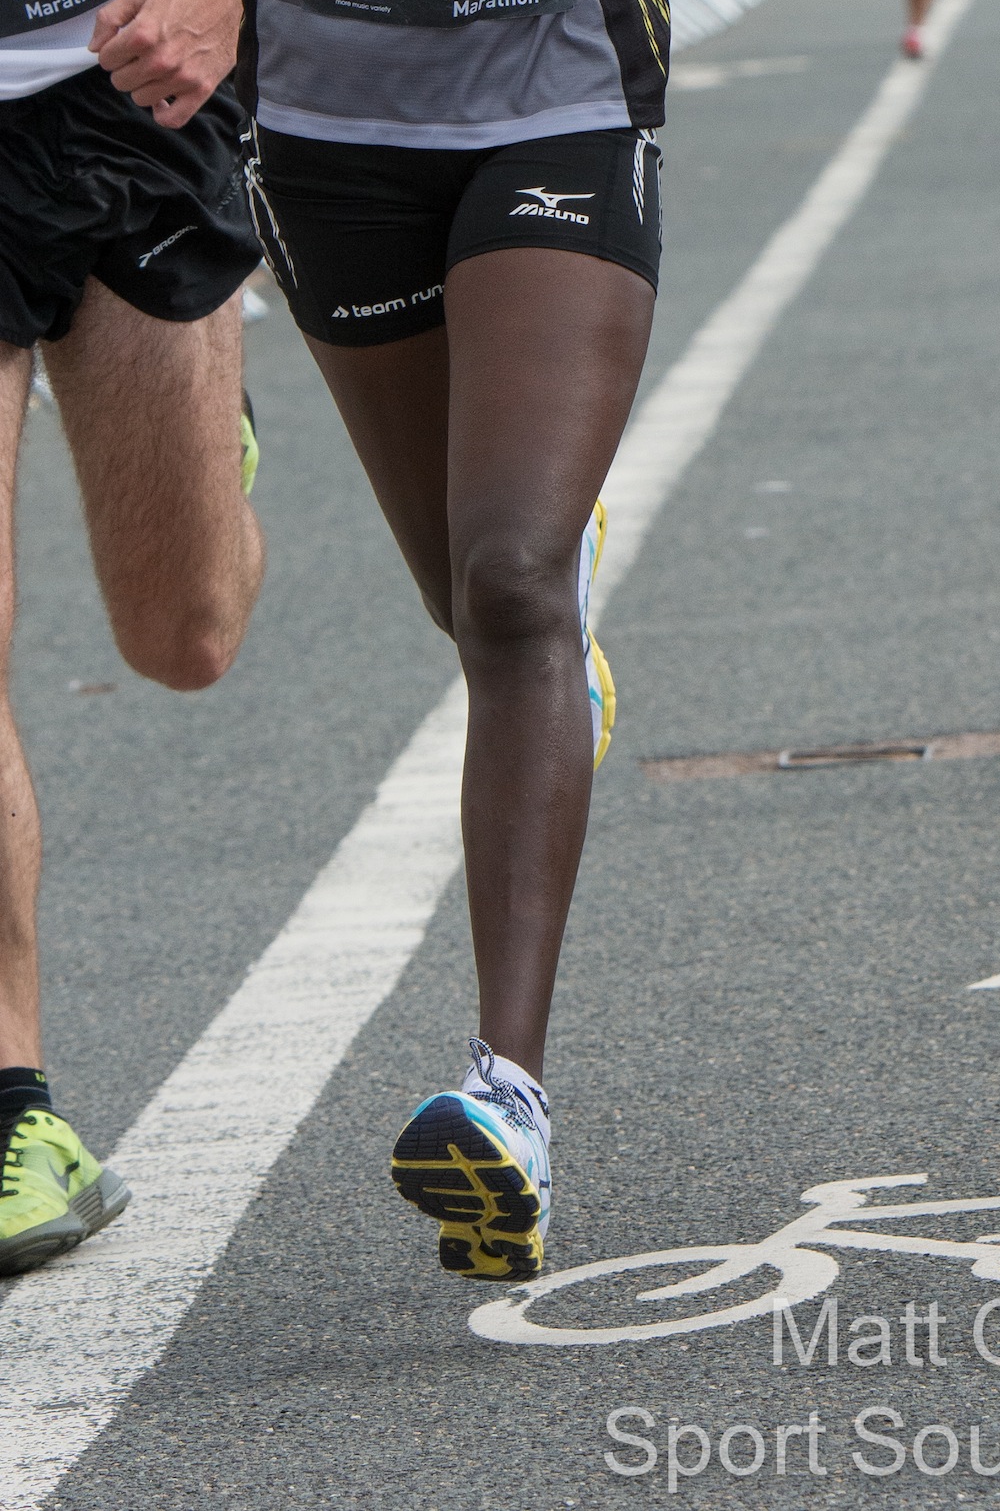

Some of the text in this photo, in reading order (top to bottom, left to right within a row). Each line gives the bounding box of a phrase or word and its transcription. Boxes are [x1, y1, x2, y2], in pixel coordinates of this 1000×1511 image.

[335, 0, 391, 14] more music variety
[352, 298, 406, 318] team
